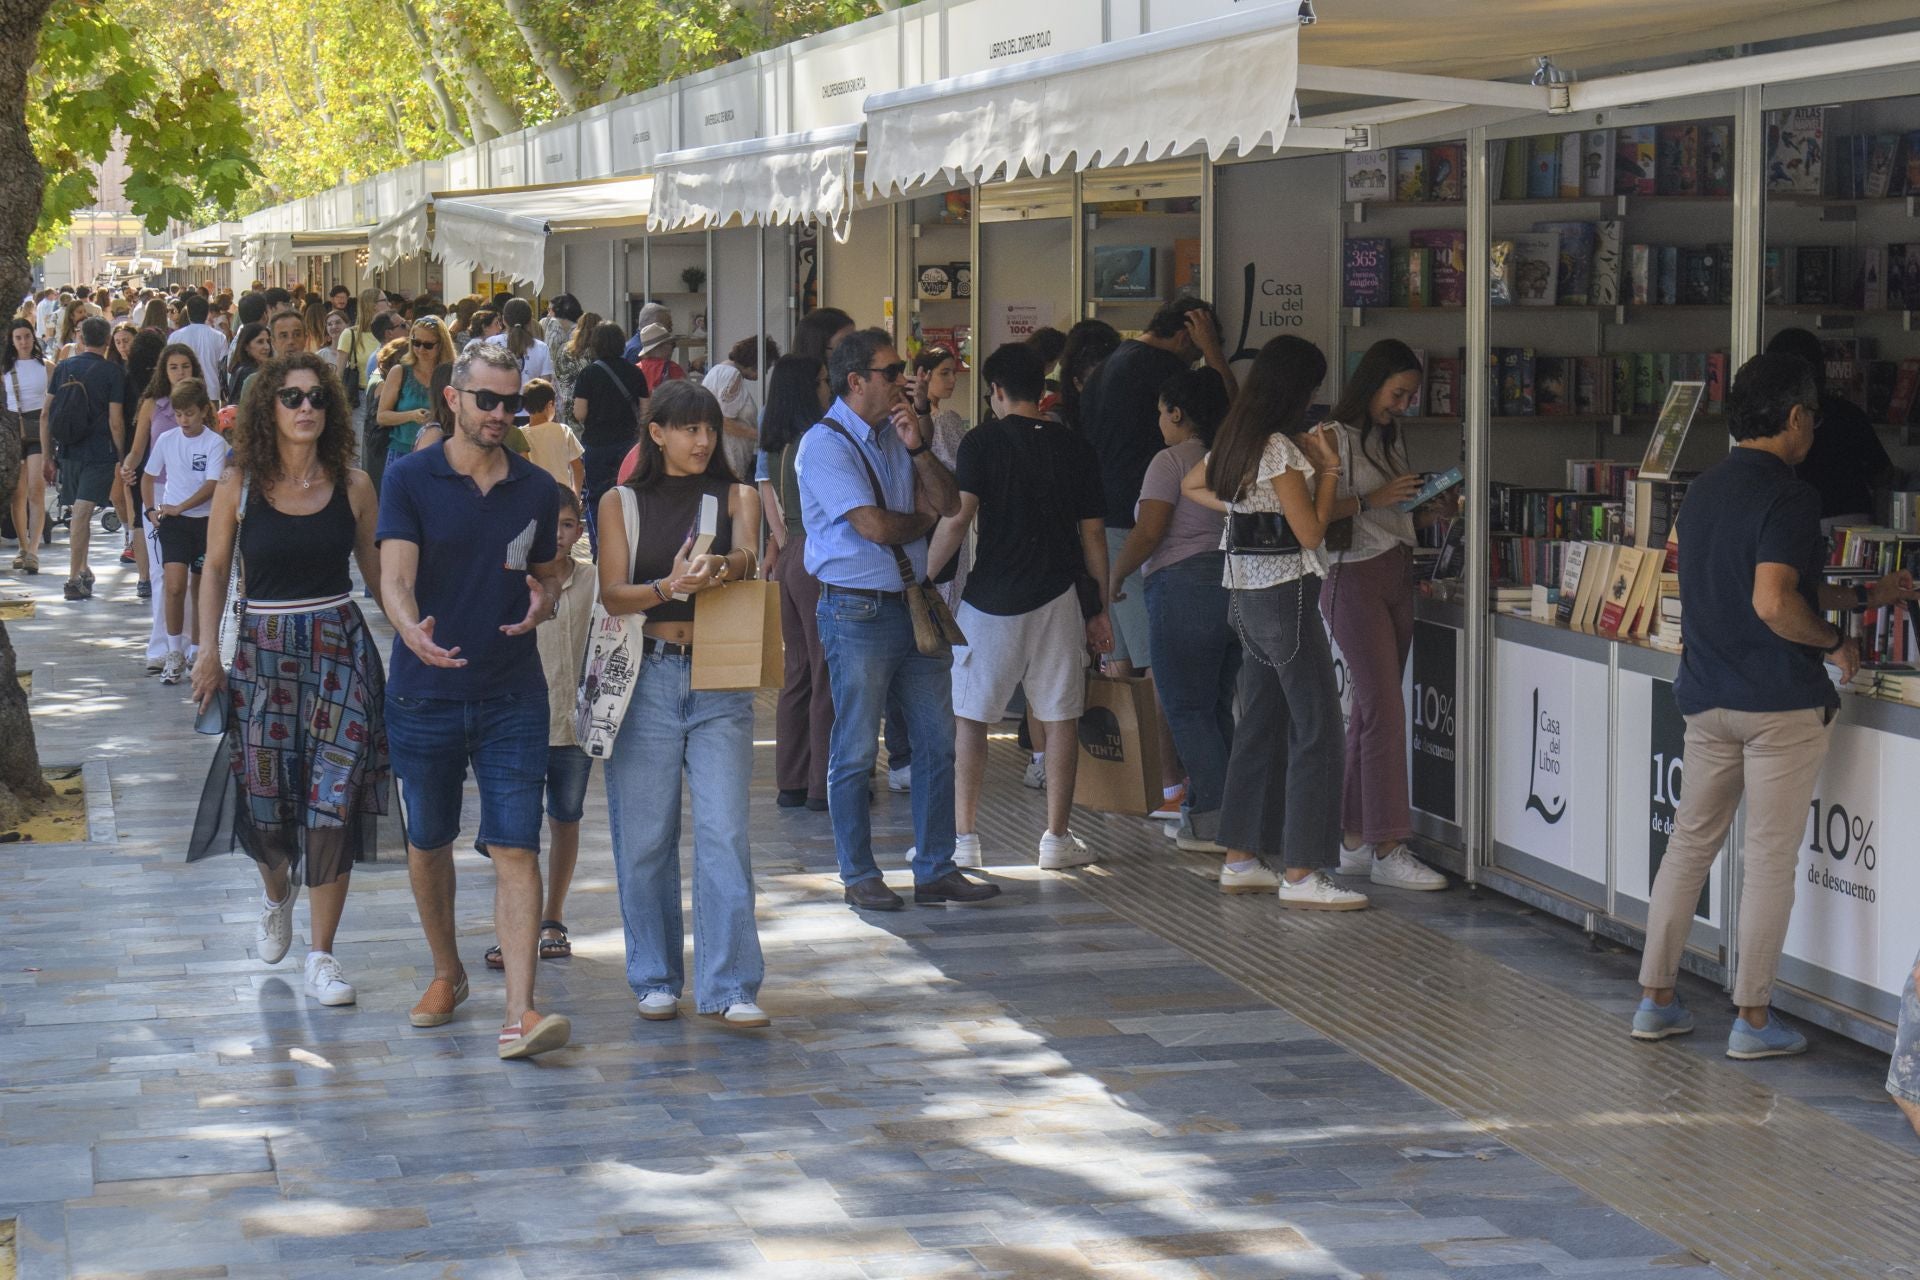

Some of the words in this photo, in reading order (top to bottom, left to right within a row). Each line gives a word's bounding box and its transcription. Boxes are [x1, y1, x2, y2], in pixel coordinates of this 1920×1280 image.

[989, 39, 1007, 60] LIBROS
[1007, 38, 1018, 56] DEL
[1018, 33, 1036, 54] ZORRO
[1036, 29, 1052, 49] ROJO
[1351, 250, 1377, 268] 365
[924, 273, 946, 281] Black
[1261, 279, 1303, 296] Casa
[1282, 298, 1304, 311] del
[1259, 311, 1304, 327] Libro
[1010, 326, 1034, 334] 100€
[267, 614, 278, 641] WHA
[1413, 683, 1455, 737] 10%
[1541, 711, 1561, 736] Casa
[1105, 734, 1120, 745] TU
[1549, 736, 1561, 755] del
[1088, 744, 1122, 757] TINTA
[1413, 734, 1422, 751] de
[1422, 738, 1455, 766] descuento
[1539, 749, 1561, 776] Libro
[1652, 812, 1663, 833] de
[1809, 798, 1876, 871] 10%
[1808, 864, 1820, 885] de
[1822, 867, 1876, 904] descuento
